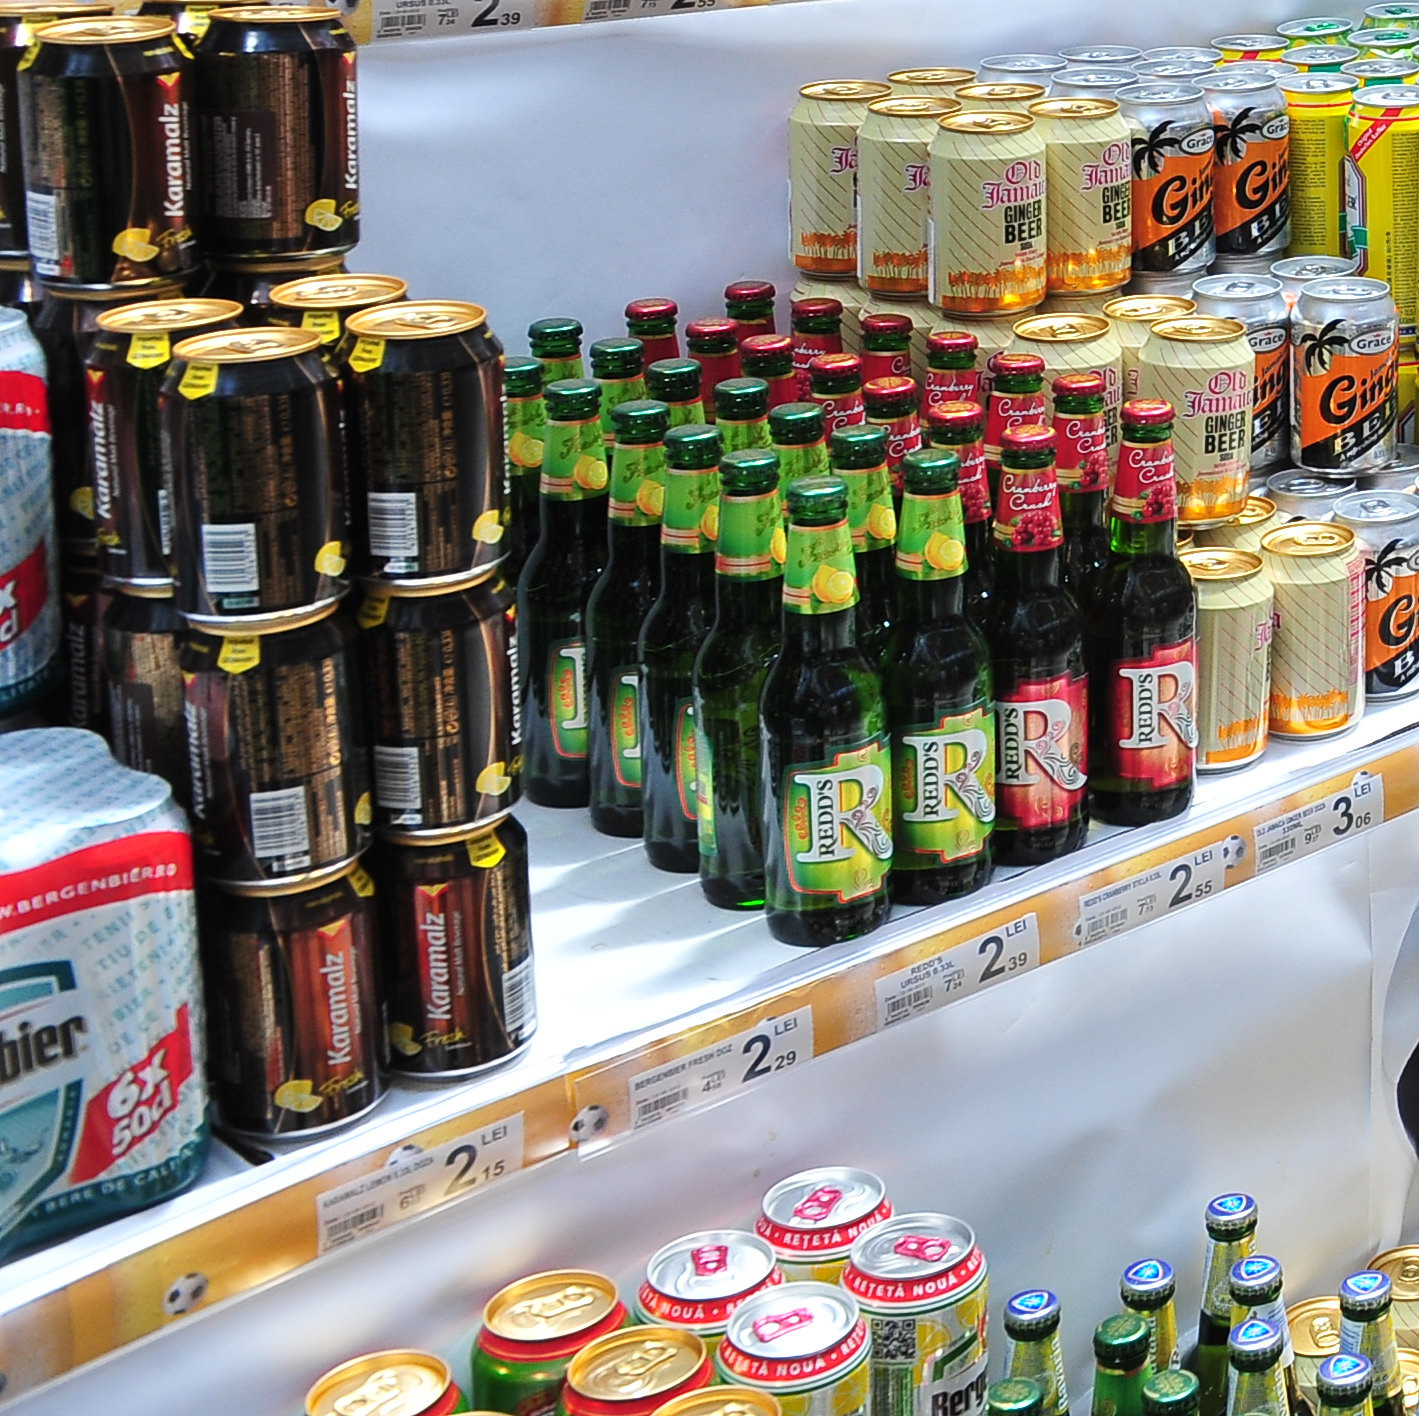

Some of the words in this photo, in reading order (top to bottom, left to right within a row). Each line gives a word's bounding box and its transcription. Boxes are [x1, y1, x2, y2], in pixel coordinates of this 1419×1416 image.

[500, 12, 521, 26] 39
[158, 103, 184, 218] Karamalz
[1004, 159, 1041, 185] Old
[1003, 199, 1043, 224] GINGER
[1004, 221, 1043, 245] BEER
[1356, 333, 1393, 351] Grace
[1208, 370, 1247, 395] Old
[1204, 411, 1246, 435] GINGER
[1204, 429, 1246, 455] BEER
[1137, 672, 1153, 746] REDD'S
[1331, 795, 1354, 837] 3
[1355, 813, 1372, 828] 06
[1167, 863, 1194, 909] 2
[1194, 880, 1213, 898] 55
[425, 910, 453, 1021] Karamalz
[978, 934, 1006, 983] 2
[1008, 952, 1029, 972] 39
[326, 950, 351, 1067] Karamalz
[741, 1034, 772, 1083] 2
[774, 1051, 797, 1071] 29
[444, 1144, 477, 1196] 2
[479, 1159, 506, 1181] 15
[783, 1233, 843, 1249] REȚETĂ
[912, 1272, 959, 1296] NOUĂ
[776, 1357, 826, 1377] NOUĂ
